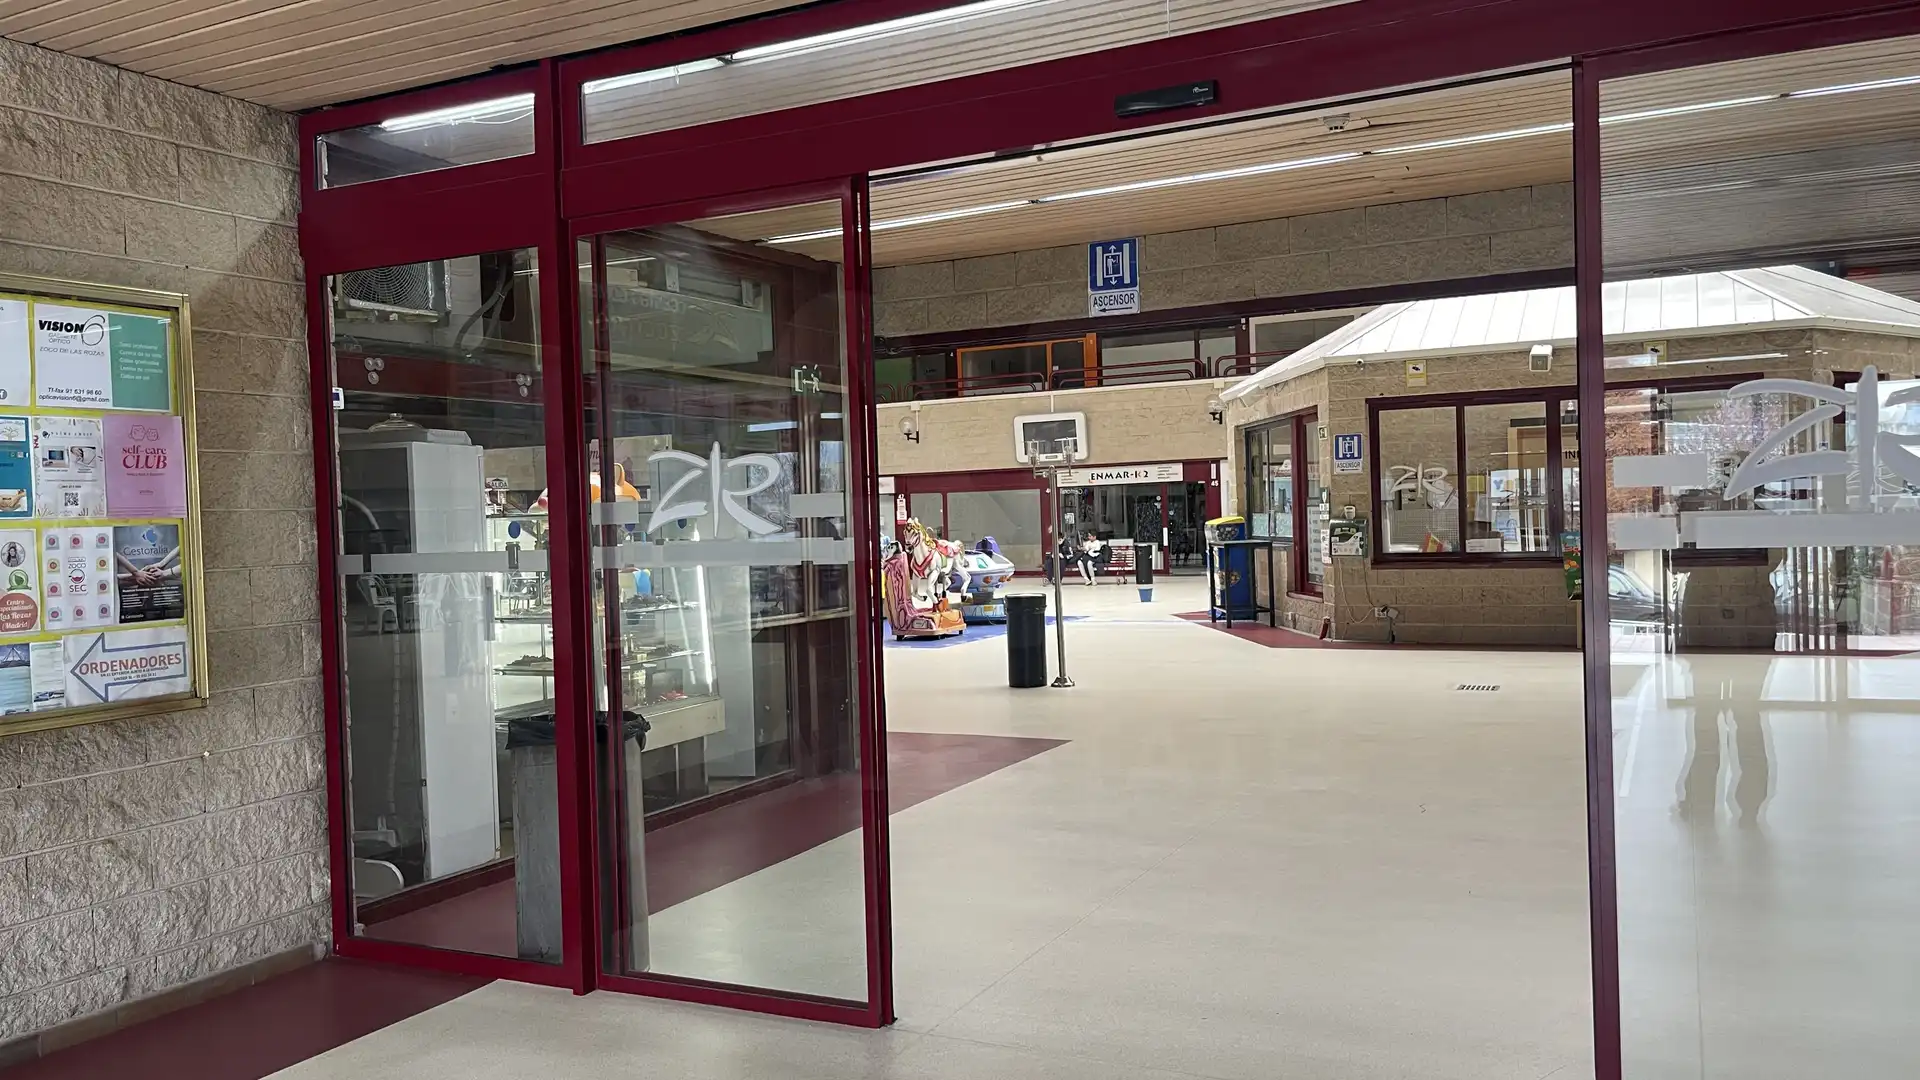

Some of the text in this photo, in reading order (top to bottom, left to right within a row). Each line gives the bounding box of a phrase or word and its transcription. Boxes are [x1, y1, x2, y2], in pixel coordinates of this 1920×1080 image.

[1093, 293, 1136, 307] ASCENSOR
[122, 444, 167, 455] self-care
[122, 454, 168, 470] CLUB
[1336, 461, 1361, 469] ASCENSOR
[69, 584, 87, 593] SEC
[78, 652, 182, 676] ORDENADORES
